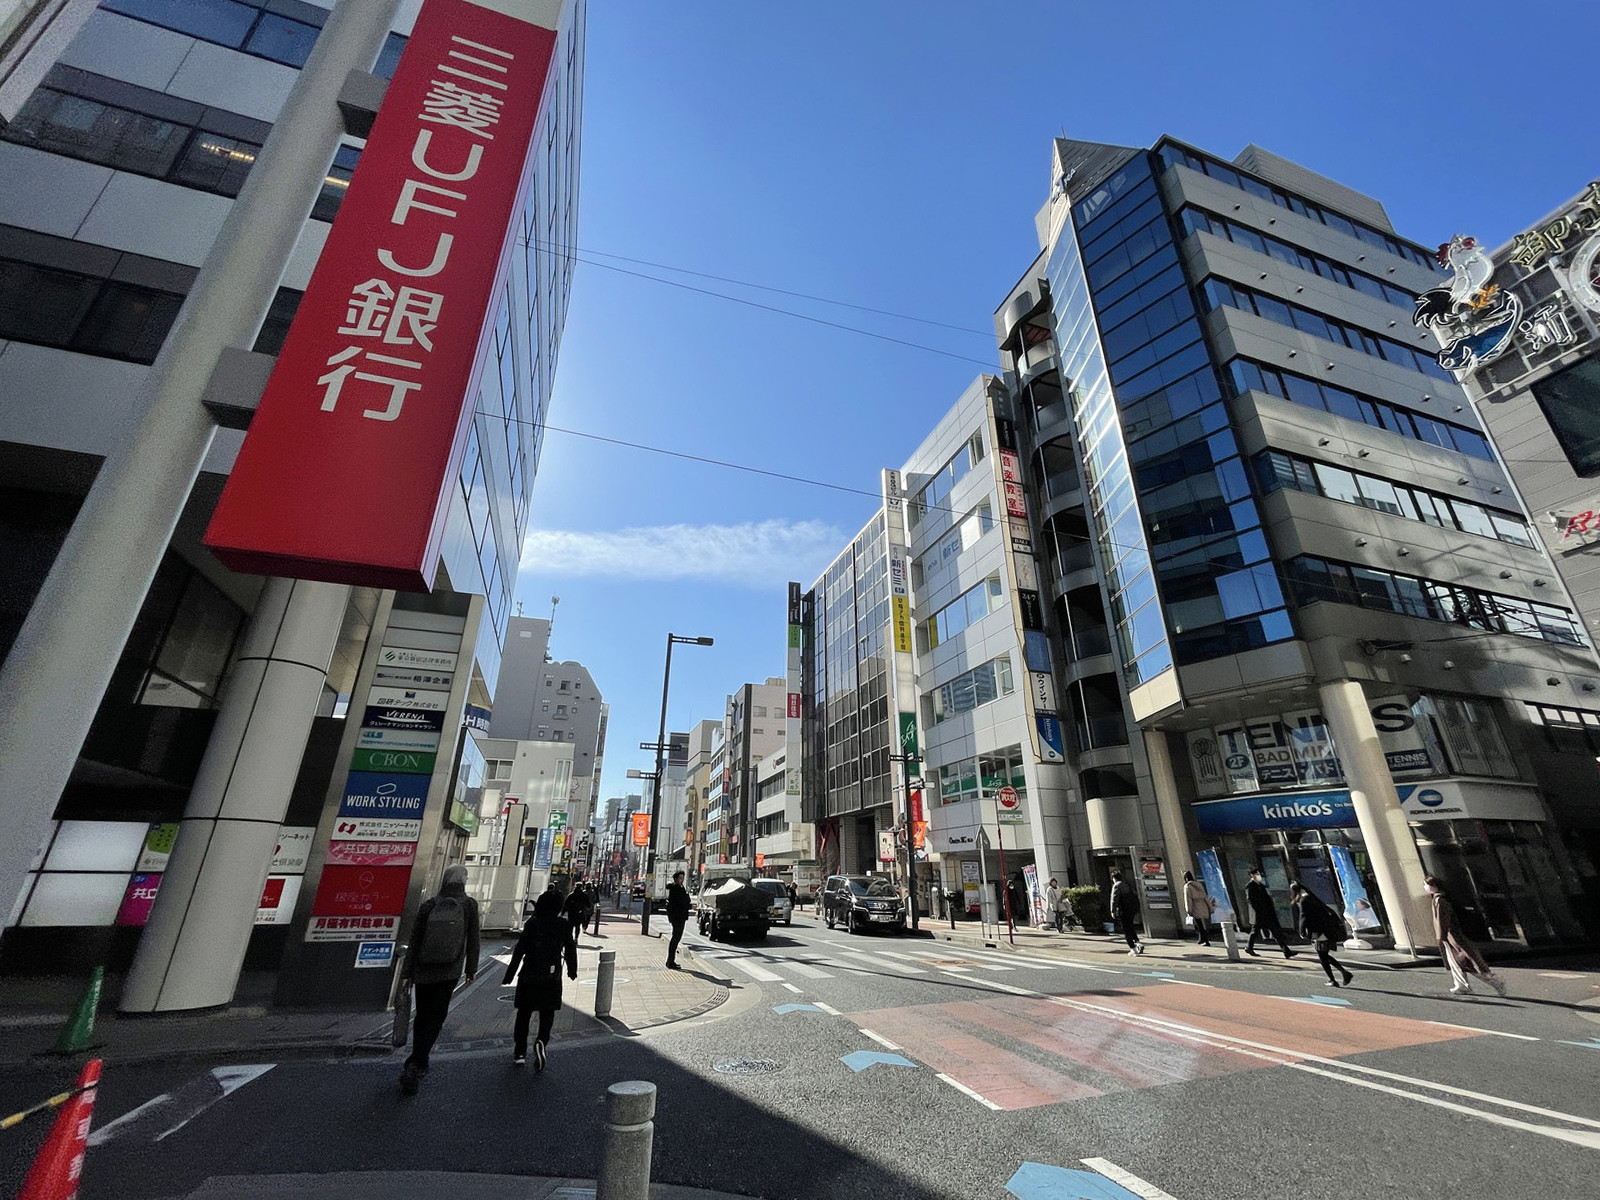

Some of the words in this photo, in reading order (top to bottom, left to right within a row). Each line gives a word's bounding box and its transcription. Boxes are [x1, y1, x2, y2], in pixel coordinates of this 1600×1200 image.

[316, 35, 514, 422] 三菱UFJ銀行
[386, 709, 425, 720] VERENA
[1230, 757, 1247, 769] 2F
[346, 795, 377, 807] WORK
[378, 796, 421, 809] STYLING
[1262, 800, 1333, 819] kinko's
[343, 843, 412, 855] 共立美容外科
[315, 917, 395, 930] 月極有料駐車場
